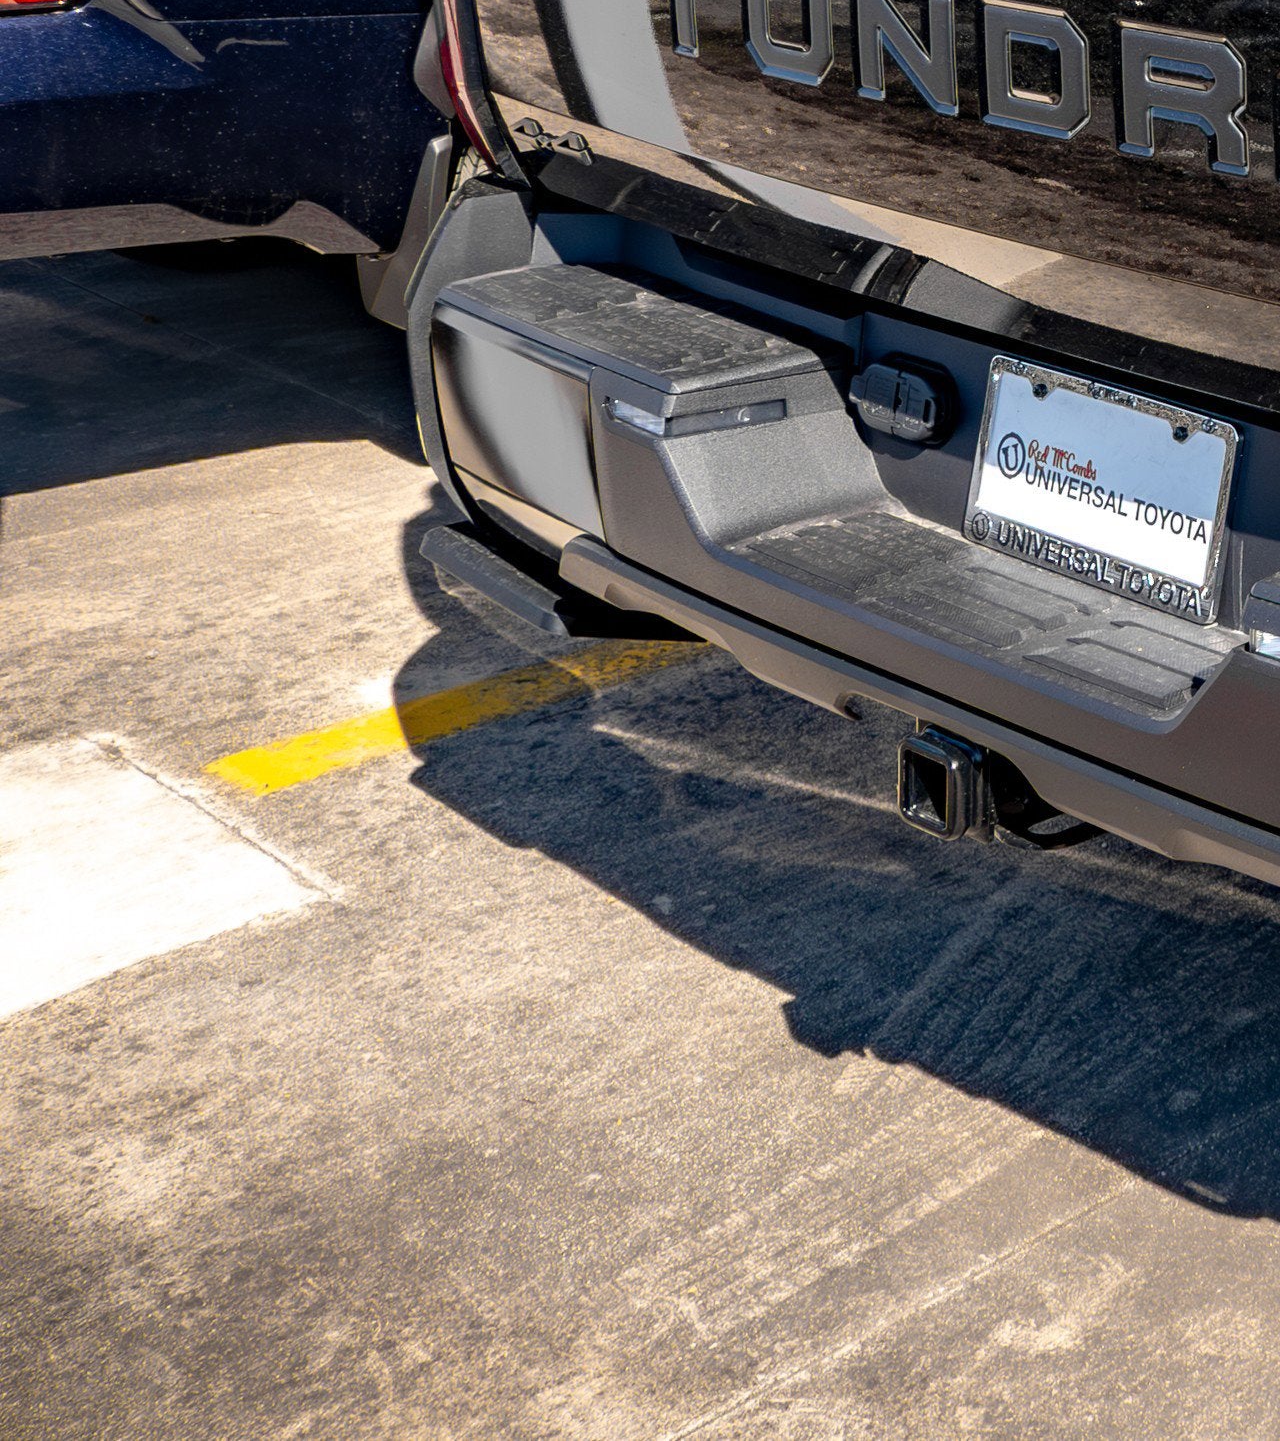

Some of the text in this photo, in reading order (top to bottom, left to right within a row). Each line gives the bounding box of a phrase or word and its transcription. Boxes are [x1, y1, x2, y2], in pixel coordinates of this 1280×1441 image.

[1028, 439, 1097, 481] Red McCombs
[1025, 462, 1207, 545] UNIVERSAL TOYOTA
[998, 519, 1203, 617] UNIVERSAL TOYOTA
